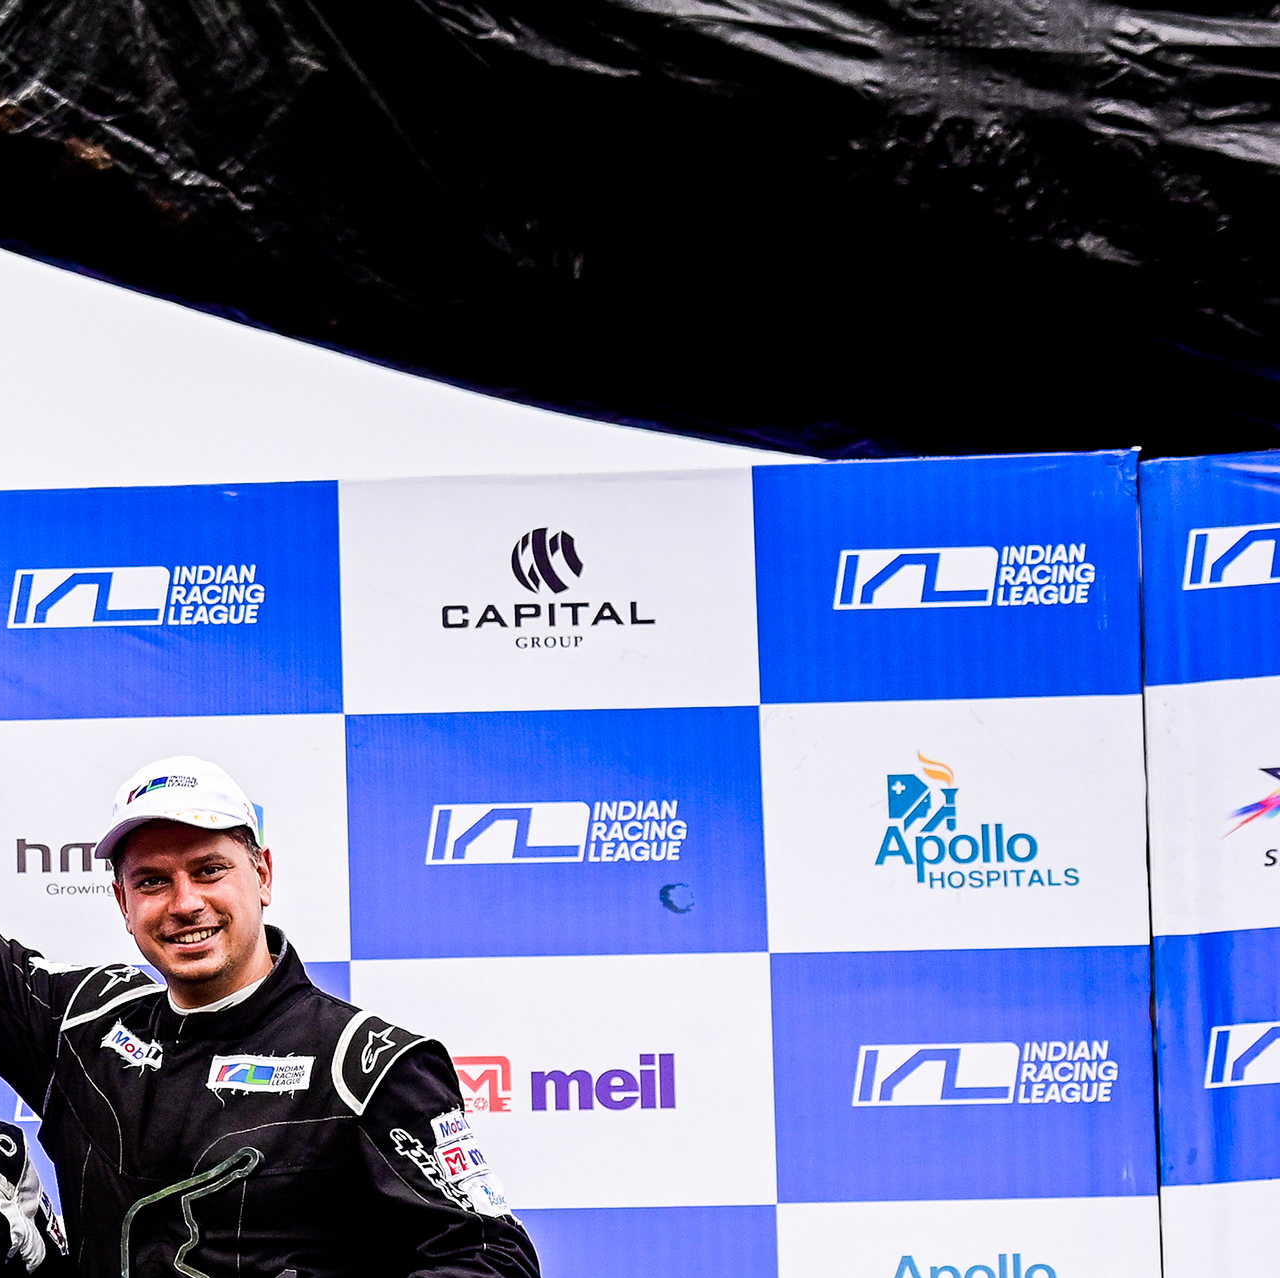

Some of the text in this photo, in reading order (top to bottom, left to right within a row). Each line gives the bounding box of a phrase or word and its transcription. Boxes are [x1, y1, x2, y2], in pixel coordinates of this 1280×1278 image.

[1001, 544, 1085, 565] INDIAN
[172, 565, 256, 585] INDIAN
[999, 564, 1095, 585] RACING
[170, 584, 265, 605] RACING
[996, 584, 1089, 606] LEAGUE
[167, 604, 259, 626] LEAGUE
[441, 601, 656, 630] CAPITAL
[515, 635, 583, 650] GROUP
[592, 800, 678, 821] INDIAN
[591, 820, 687, 842] RACING
[588, 840, 680, 862] LEAGUE
[875, 824, 1038, 884] Apollo
[929, 867, 1080, 889] HOSPITALS
[111, 1030, 145, 1060] Mob
[1023, 1040, 1109, 1061] INDIAN
[271, 1078, 301, 1086] LEAGUE
[274, 1071, 305, 1080] RACING
[531, 1053, 676, 1111] meil
[1020, 1060, 1118, 1083] RACING
[1017, 1081, 1112, 1104] LEAGUE
